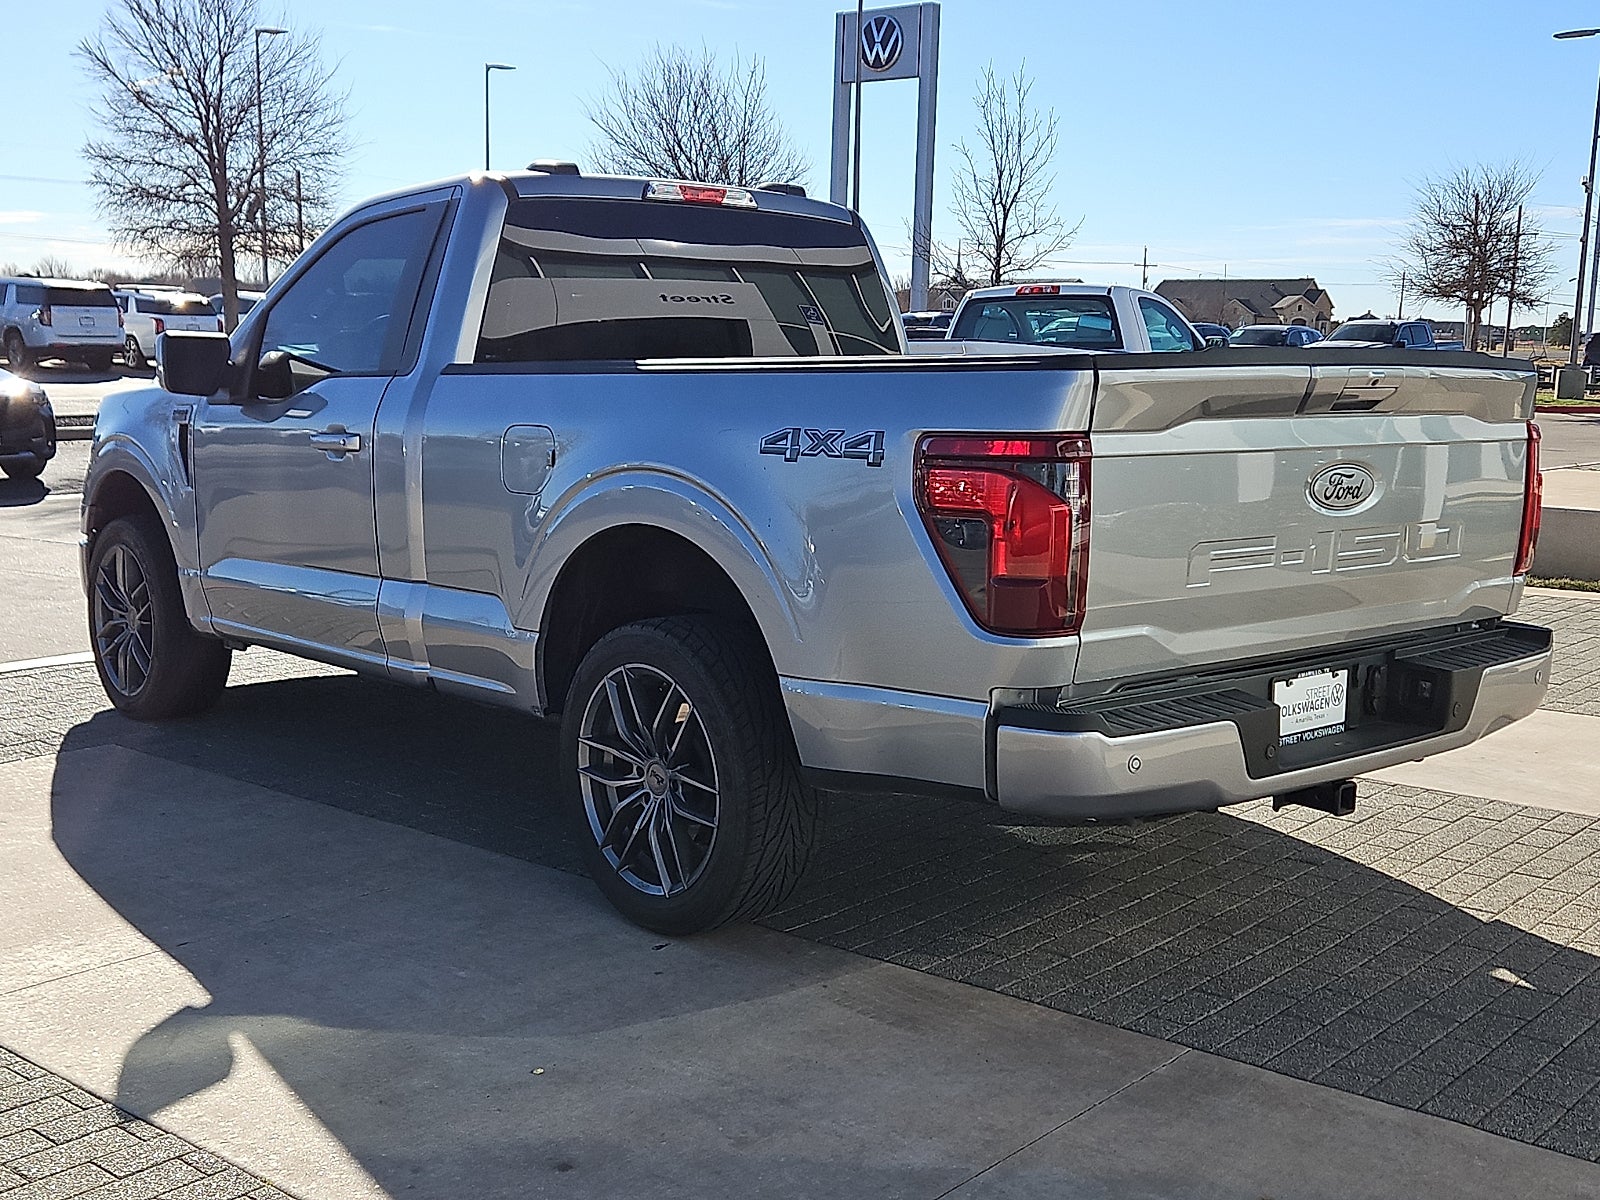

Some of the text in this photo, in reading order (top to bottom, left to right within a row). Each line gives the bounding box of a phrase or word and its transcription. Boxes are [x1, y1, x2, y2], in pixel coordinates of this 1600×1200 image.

[1324, 472, 1365, 501] Ford
[1186, 518, 1465, 588] F-150
[1306, 685, 1331, 700] STREET
[1281, 697, 1330, 717] OLKSWAGEN
[1302, 724, 1345, 741] VOLKSWAGEN
